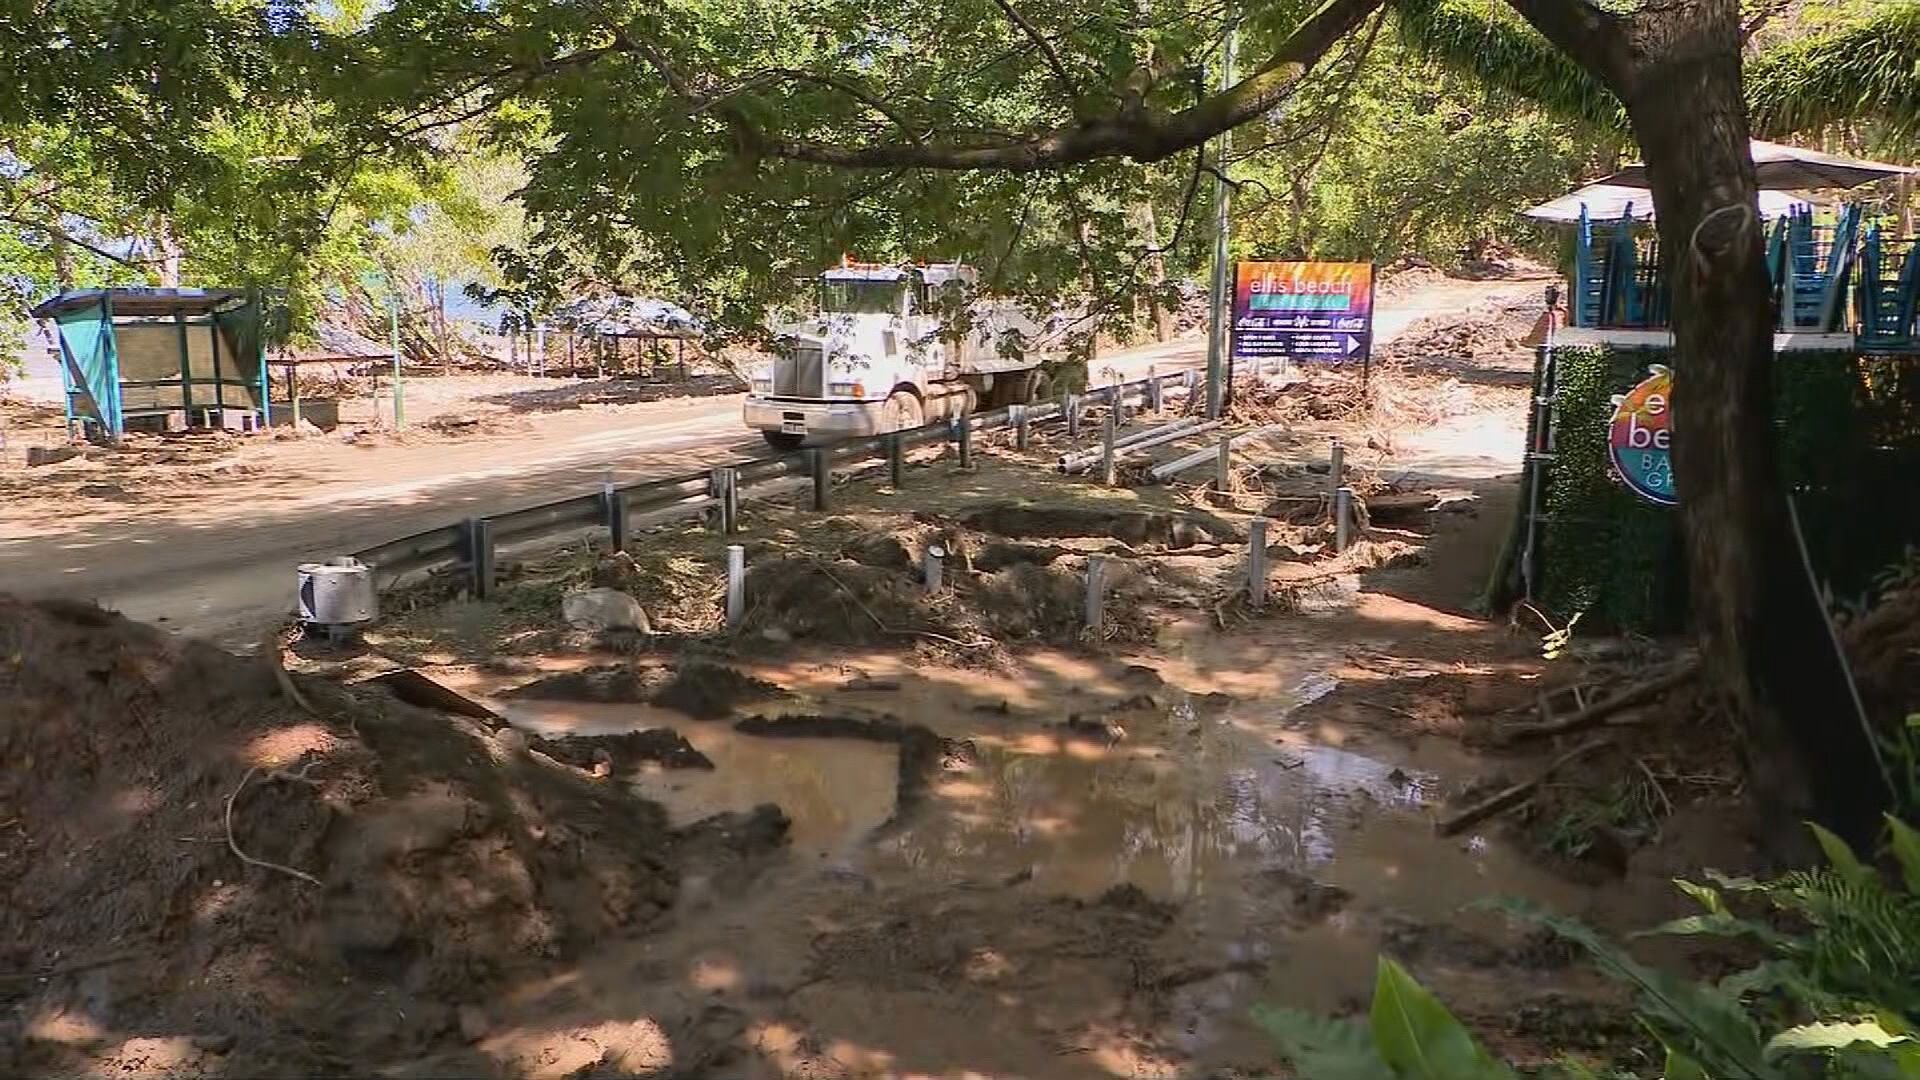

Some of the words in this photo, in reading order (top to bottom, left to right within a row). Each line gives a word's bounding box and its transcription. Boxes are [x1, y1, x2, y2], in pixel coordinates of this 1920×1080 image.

[1250, 272, 1287, 293] ellis
[1294, 273, 1351, 294] beach
[1645, 394, 1665, 415] e
[1629, 412, 1670, 448] be
[1642, 454, 1670, 470] BA
